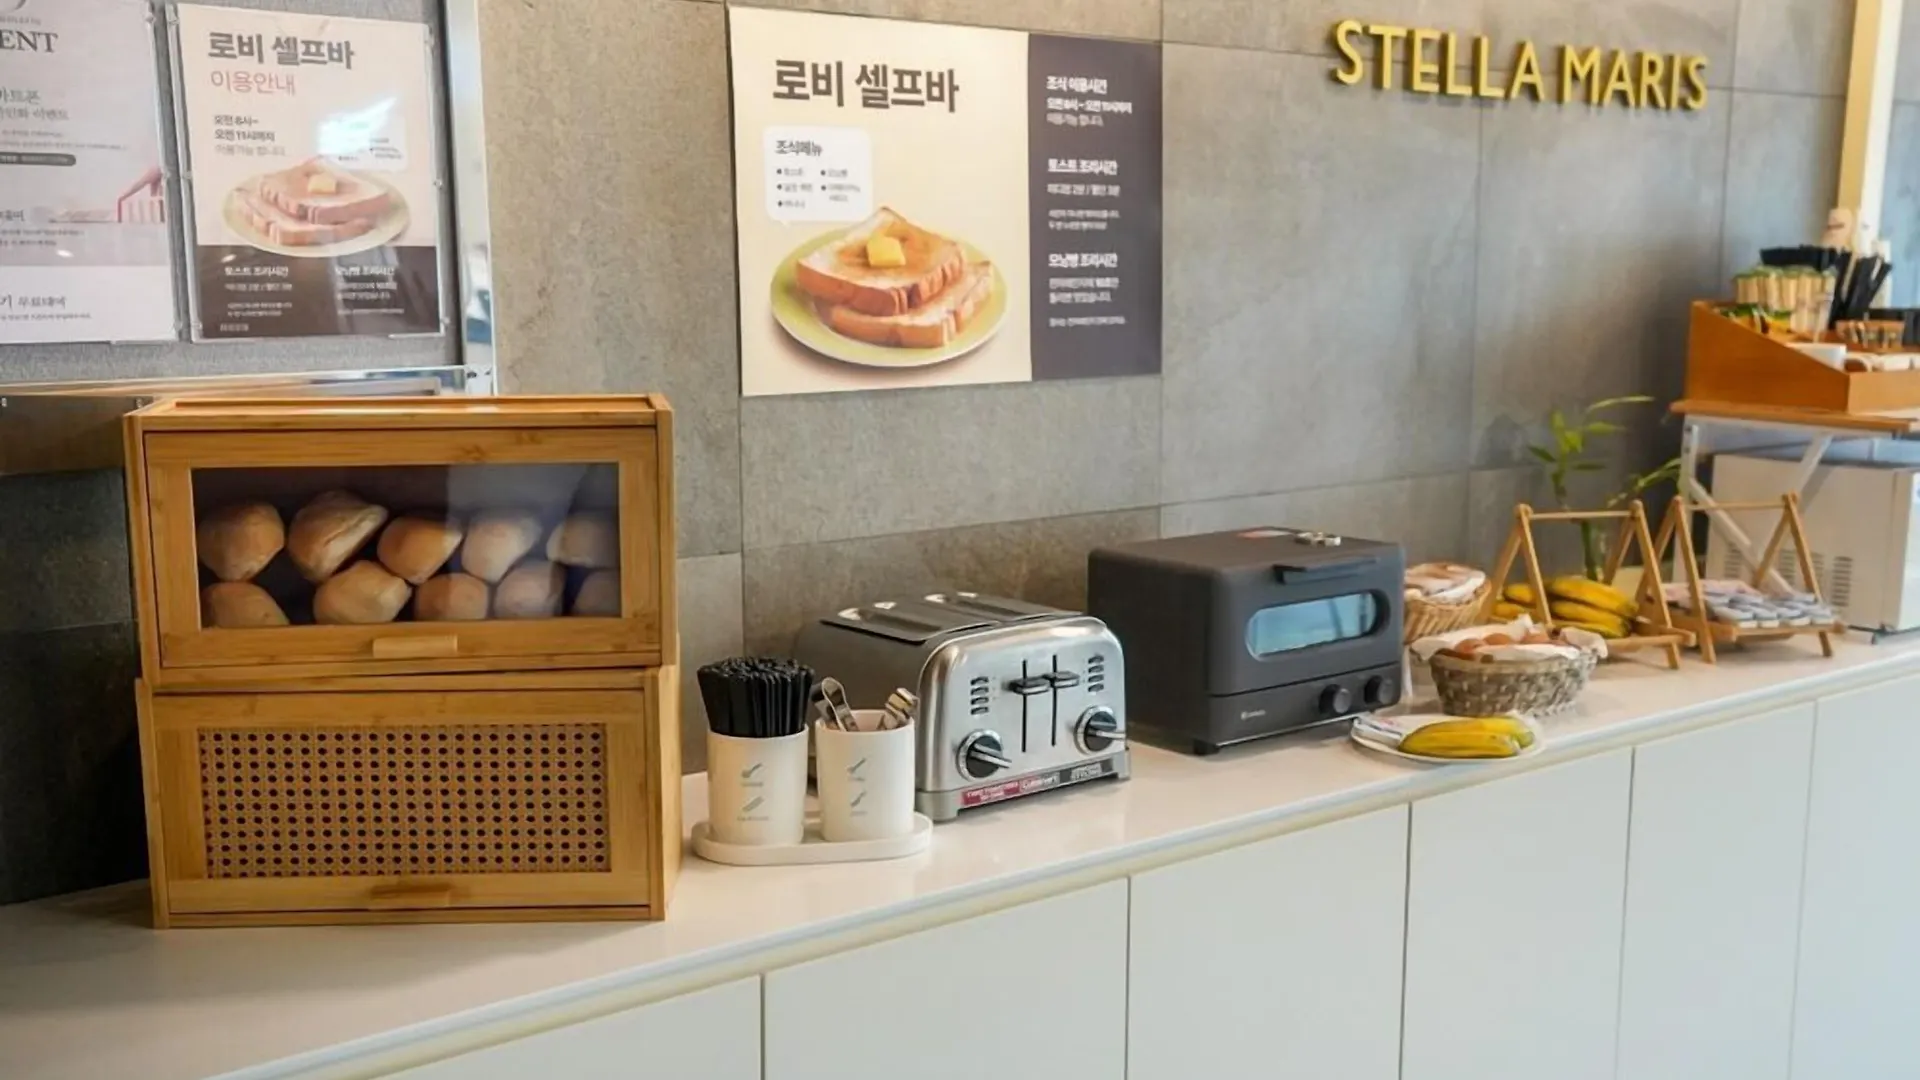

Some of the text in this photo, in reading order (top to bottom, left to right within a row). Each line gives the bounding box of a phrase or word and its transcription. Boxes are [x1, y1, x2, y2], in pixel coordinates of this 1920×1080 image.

[208, 32, 355, 70] 로비 셀프바
[1332, 19, 1709, 111] STELLA MARIS
[210, 70, 296, 96] 이용안내
[773, 59, 960, 113] 로비 셀프바
[1046, 75, 1108, 95] 조식 이용시간
[775, 139, 822, 157] 조식메뉴
[1047, 158, 1118, 176] 토스트 조리시간
[1048, 252, 1118, 268] 모닝빵 조리시간
